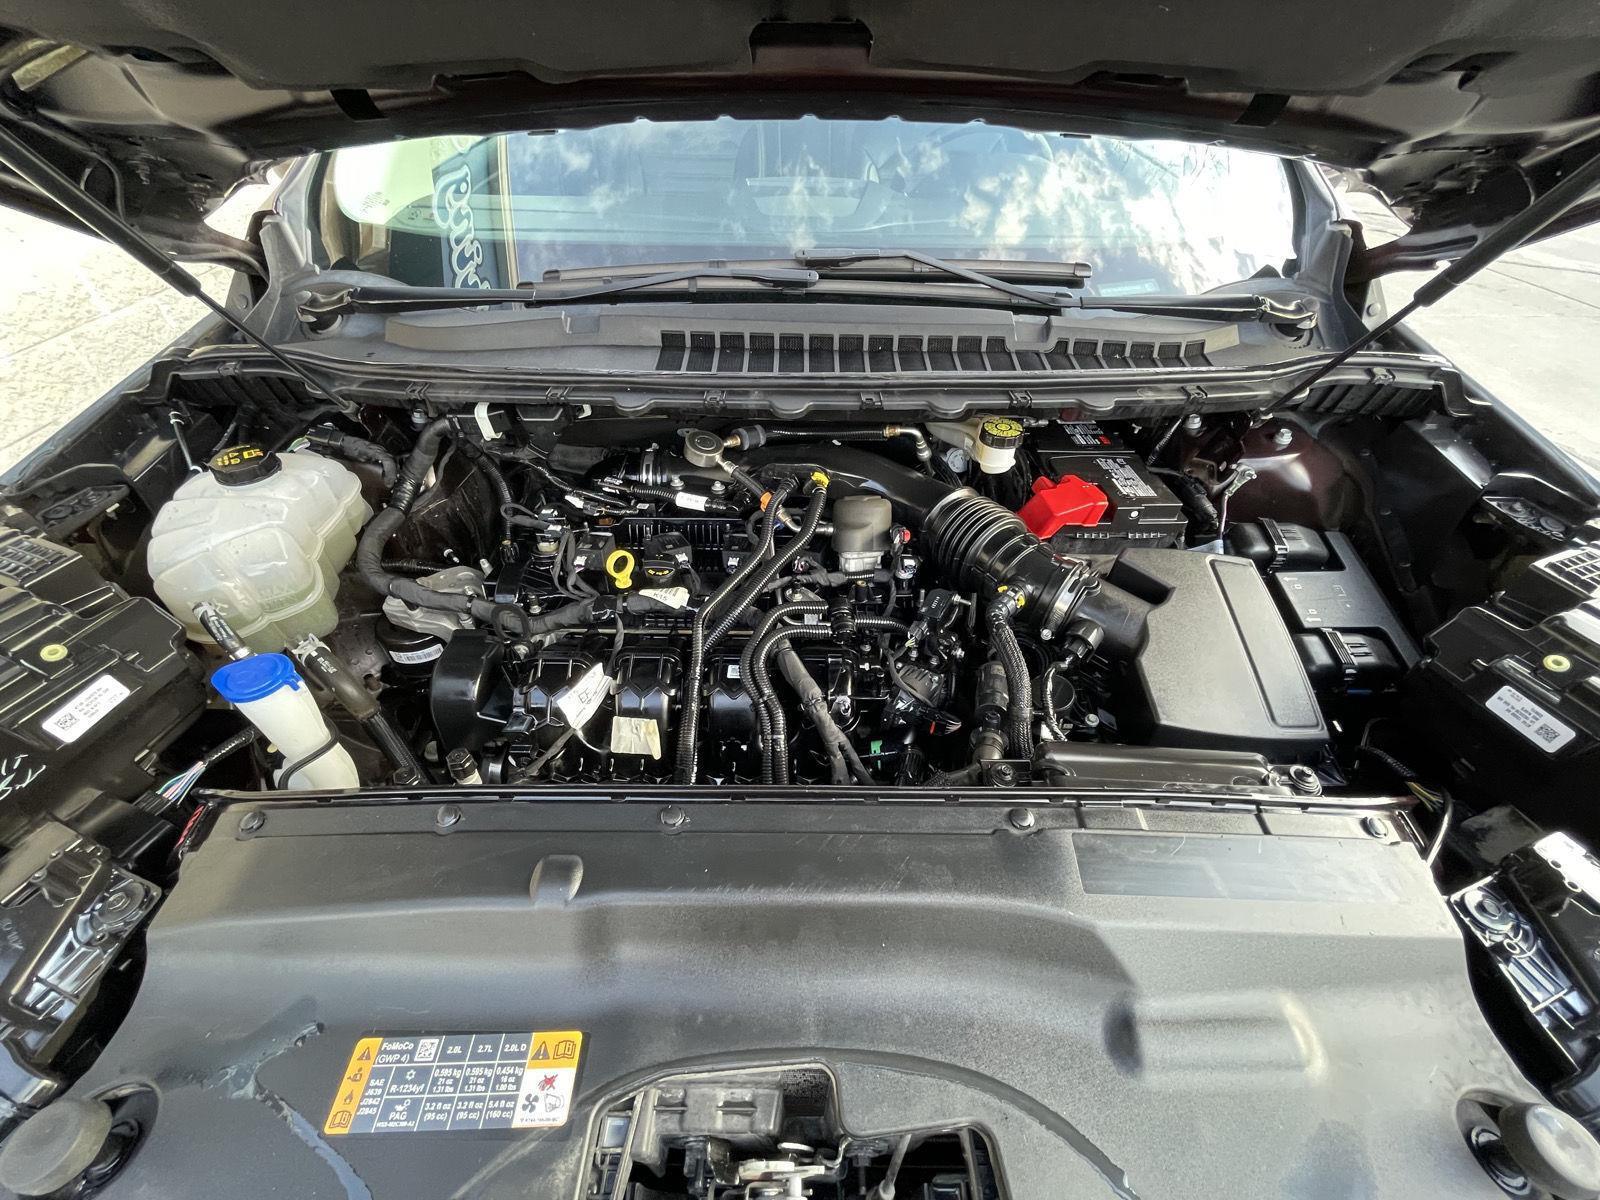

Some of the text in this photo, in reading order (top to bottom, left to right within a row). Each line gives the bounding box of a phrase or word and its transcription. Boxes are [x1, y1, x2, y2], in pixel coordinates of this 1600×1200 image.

[381, 1042, 414, 1051] FoMoCo
[446, 1045, 462, 1054] 2.0L
[477, 1044, 493, 1053] 2.7L
[504, 1043, 527, 1052] 2.0L D
[375, 1053, 410, 1065] (GWP 4)
[434, 1067, 462, 1078] 0.595 kg
[465, 1067, 493, 1077] 0.595 kg
[496, 1066, 524, 1076] 0.454 kg
[369, 1079, 385, 1087] SAE
[390, 1084, 425, 1095] R-1234yf
[456, 1101, 468, 1109] 3.2
[389, 1111, 407, 1121] PAG
[424, 1112, 448, 1121] (95 cc)
[456, 1111, 480, 1120] (95 cc)
[486, 1110, 513, 1119] (160 cc)
